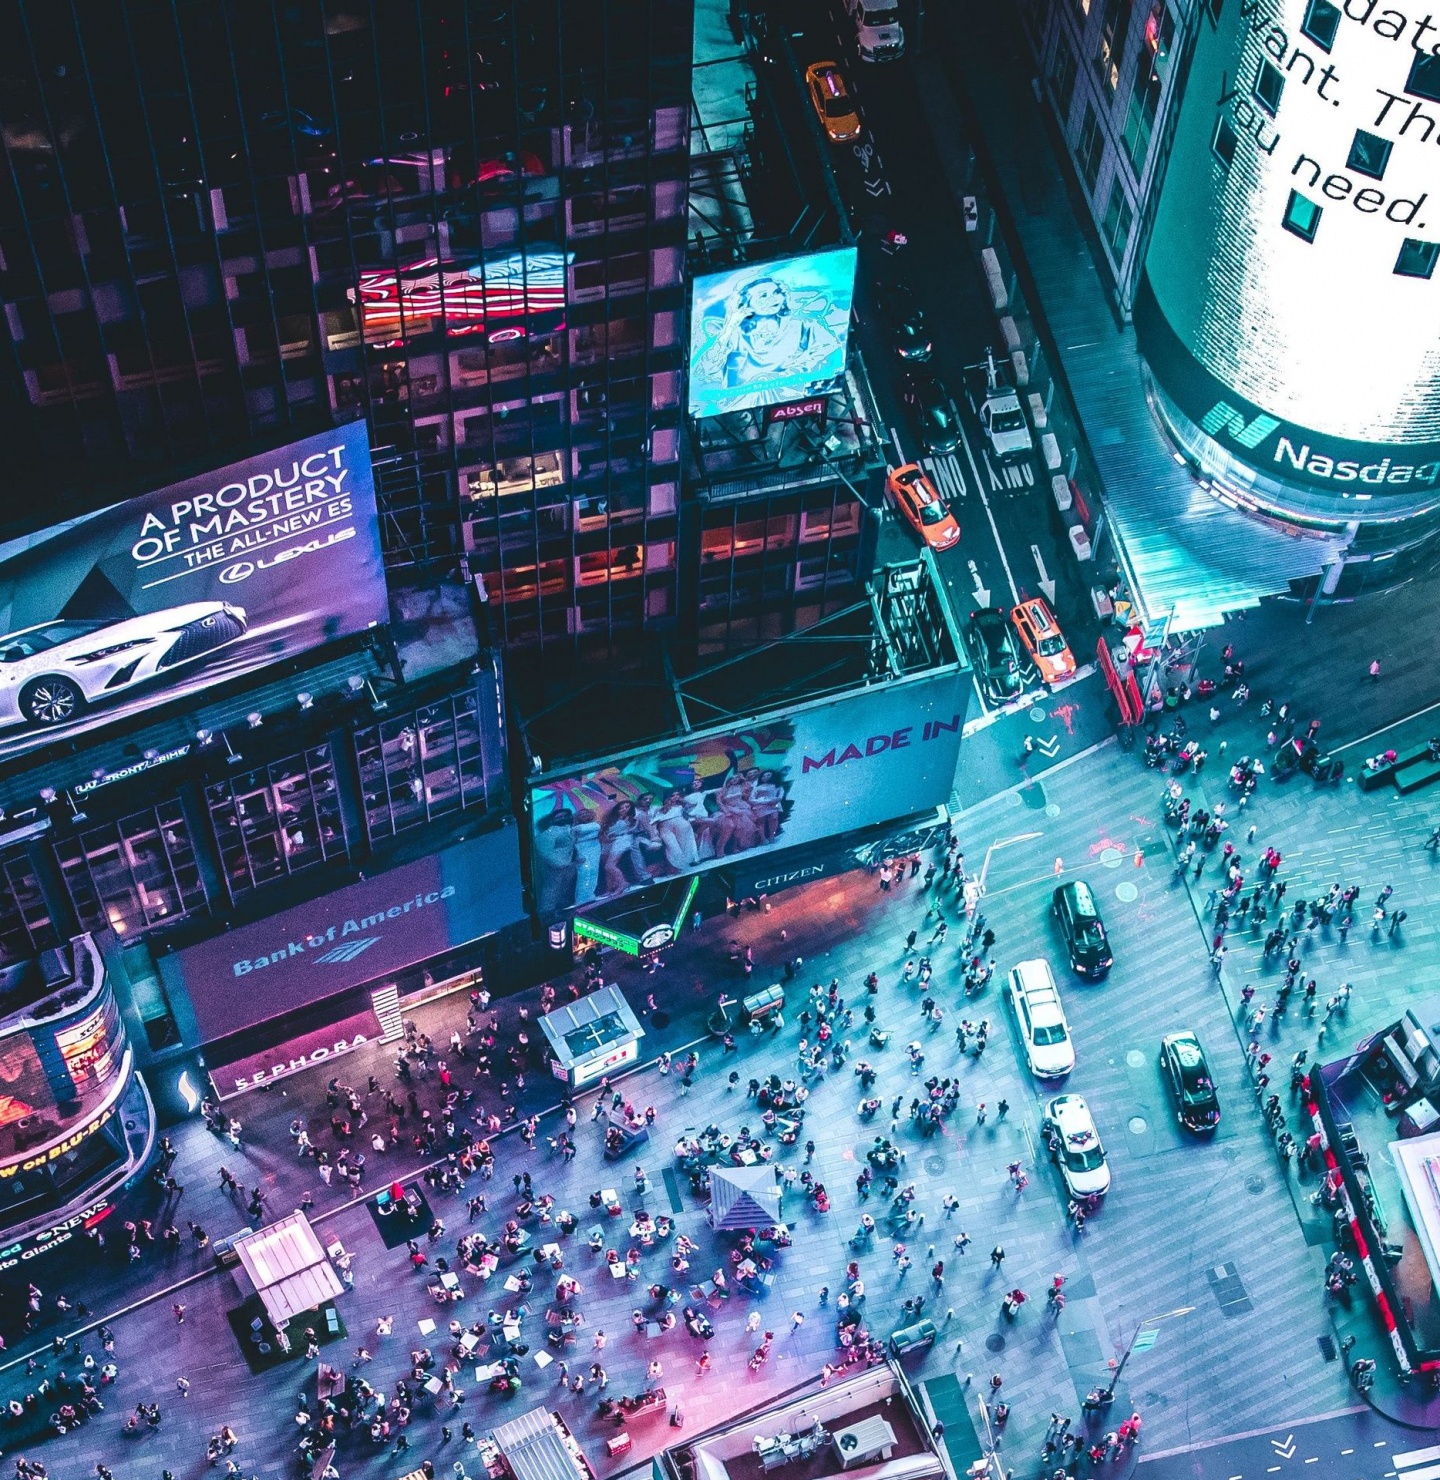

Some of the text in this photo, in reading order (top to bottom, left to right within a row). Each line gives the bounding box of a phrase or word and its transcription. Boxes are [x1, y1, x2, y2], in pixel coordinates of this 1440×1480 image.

[1343, 0, 1440, 58] dat
[1376, 88, 1440, 146] Th
[1216, 69, 1428, 229] you need.
[773, 402, 822, 418] Absen
[917, 454, 966, 499] ONL
[1273, 436, 1440, 485] Nasdaq
[131, 468, 349, 561] OF MASTERY
[140, 444, 346, 537] A PRODUCT
[183, 498, 353, 567] THE ALL-NEW ES
[257, 527, 357, 569] LEXUS
[802, 714, 960, 773] MADE IN
[754, 863, 825, 889] CITIZEN
[232, 885, 456, 978] Bank of America
[235, 1034, 368, 1091] SEPHORA
[22, 1155, 47, 1171] ON
[21, 1232, 73, 1260] Giants
[51, 1199, 108, 1237] NEWS
